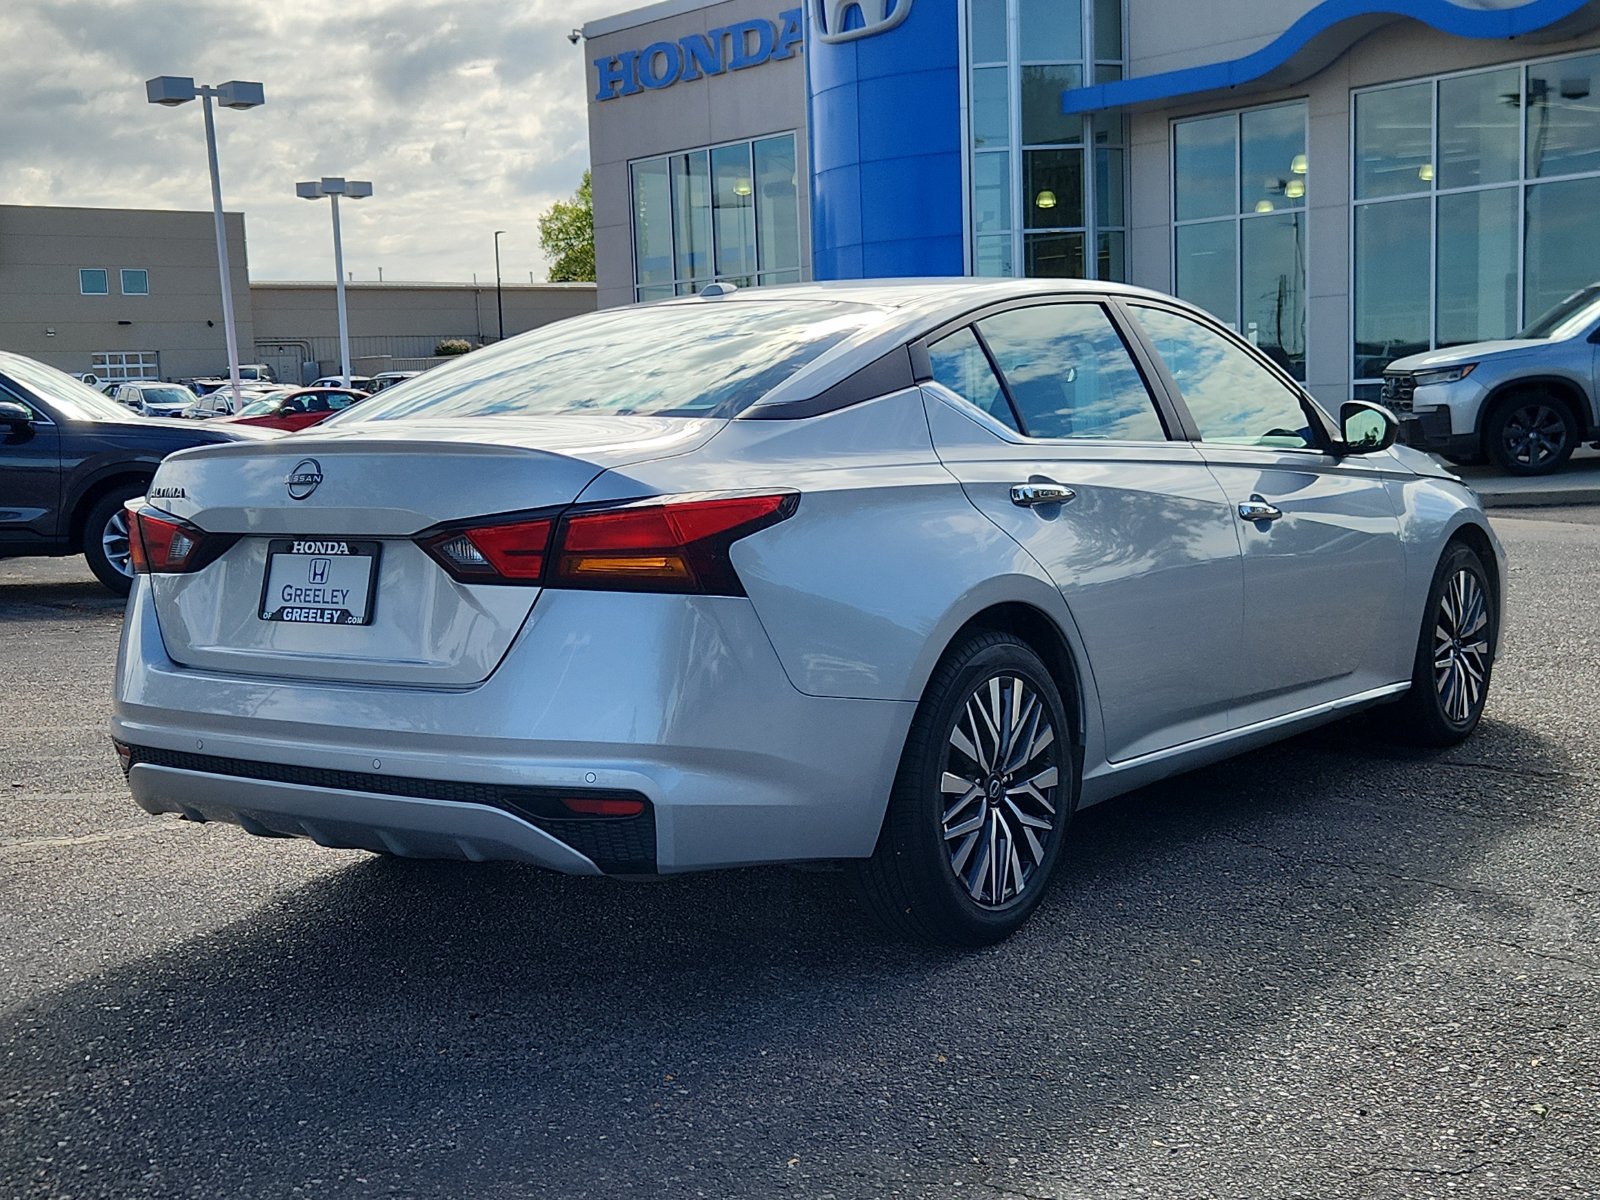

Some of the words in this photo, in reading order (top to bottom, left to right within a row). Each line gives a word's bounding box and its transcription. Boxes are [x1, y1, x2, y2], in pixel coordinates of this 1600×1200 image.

[594, 7, 803, 101] HONDA
[284, 474, 322, 483] SSAN
[151, 487, 186, 498] ALTIMA
[292, 541, 350, 554] HONDA
[281, 584, 350, 605] GREELEY
[283, 608, 341, 623] GREELEY
